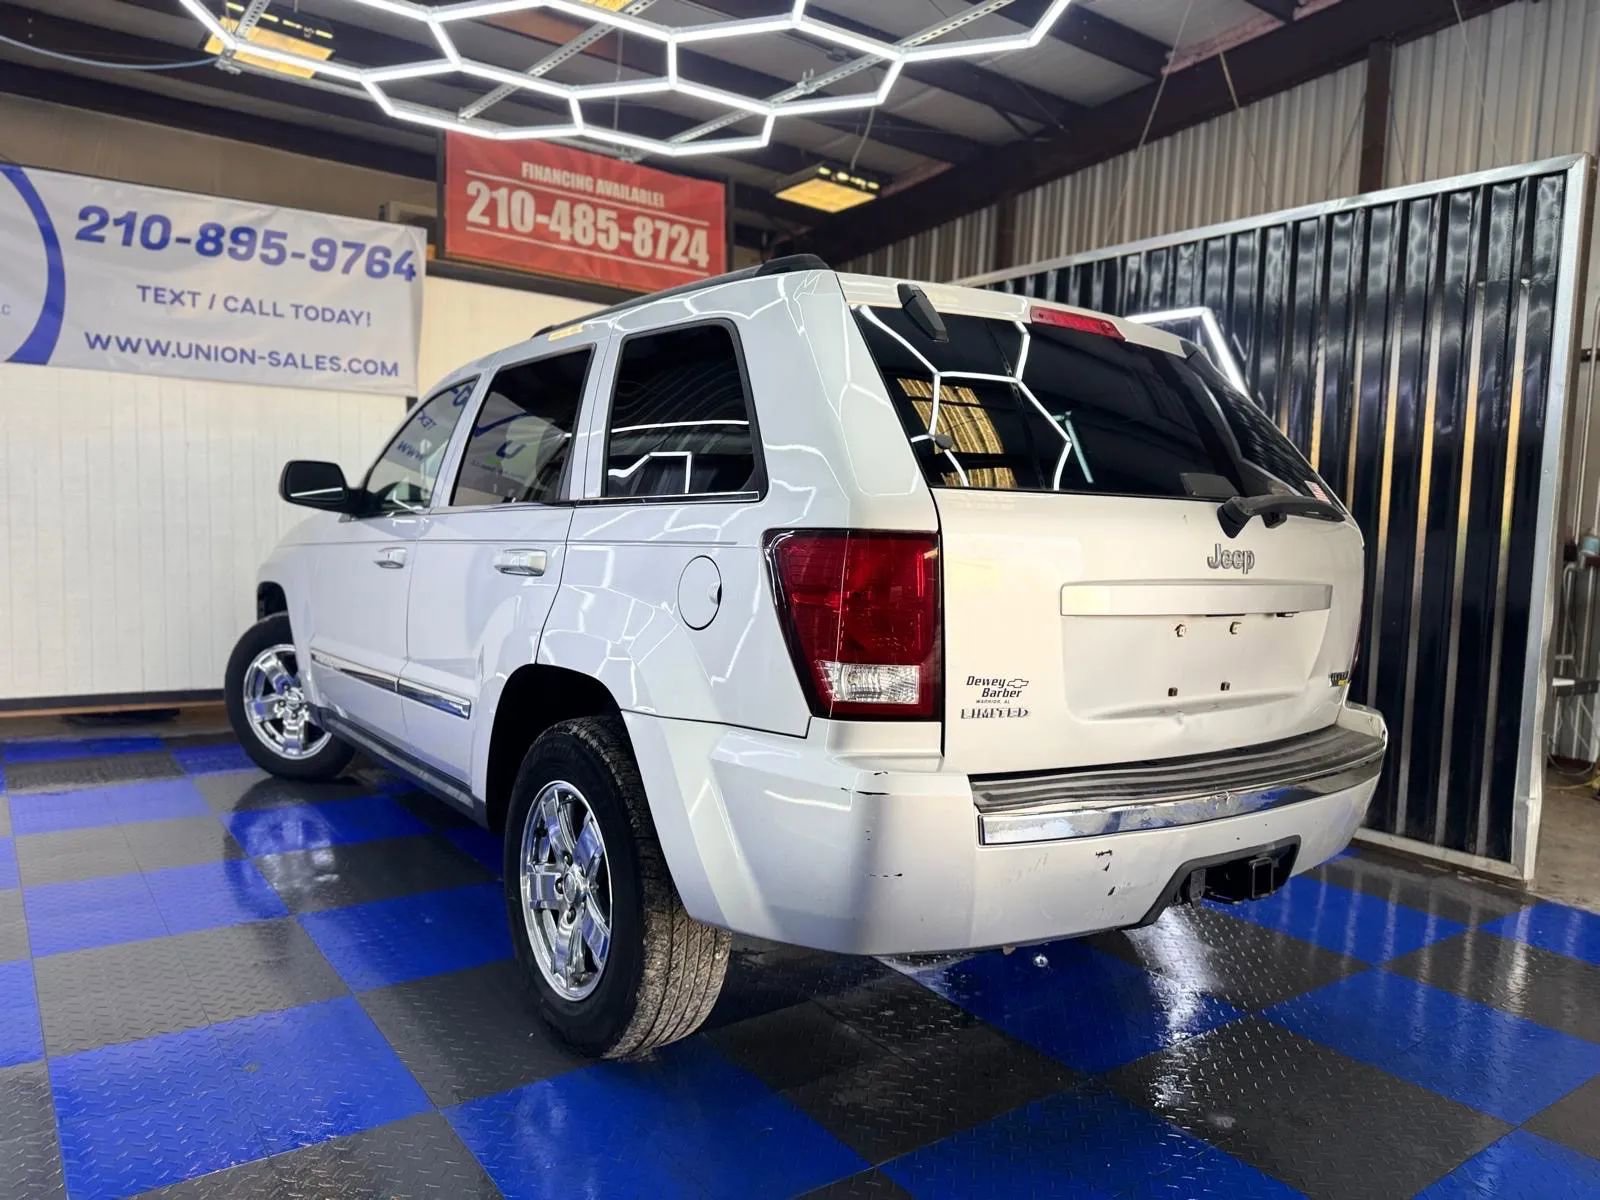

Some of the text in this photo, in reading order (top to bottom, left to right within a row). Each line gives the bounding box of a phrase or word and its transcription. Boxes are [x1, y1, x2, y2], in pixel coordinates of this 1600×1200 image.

[521, 161, 665, 208] FINANCING AVAILABLE!
[75, 205, 417, 282] 210-895-9764
[466, 181, 710, 268] 210-485-8724
[137, 285, 201, 309] TEXT
[223, 295, 285, 318] CALL
[290, 304, 372, 328] TODAY!
[84, 332, 399, 377] WWW.UNION-SALES.COM
[1207, 543, 1255, 574] Jeep
[966, 676, 1006, 688] Dewey
[981, 688, 1022, 698] Barber
[960, 708, 1029, 719] LIMITED
